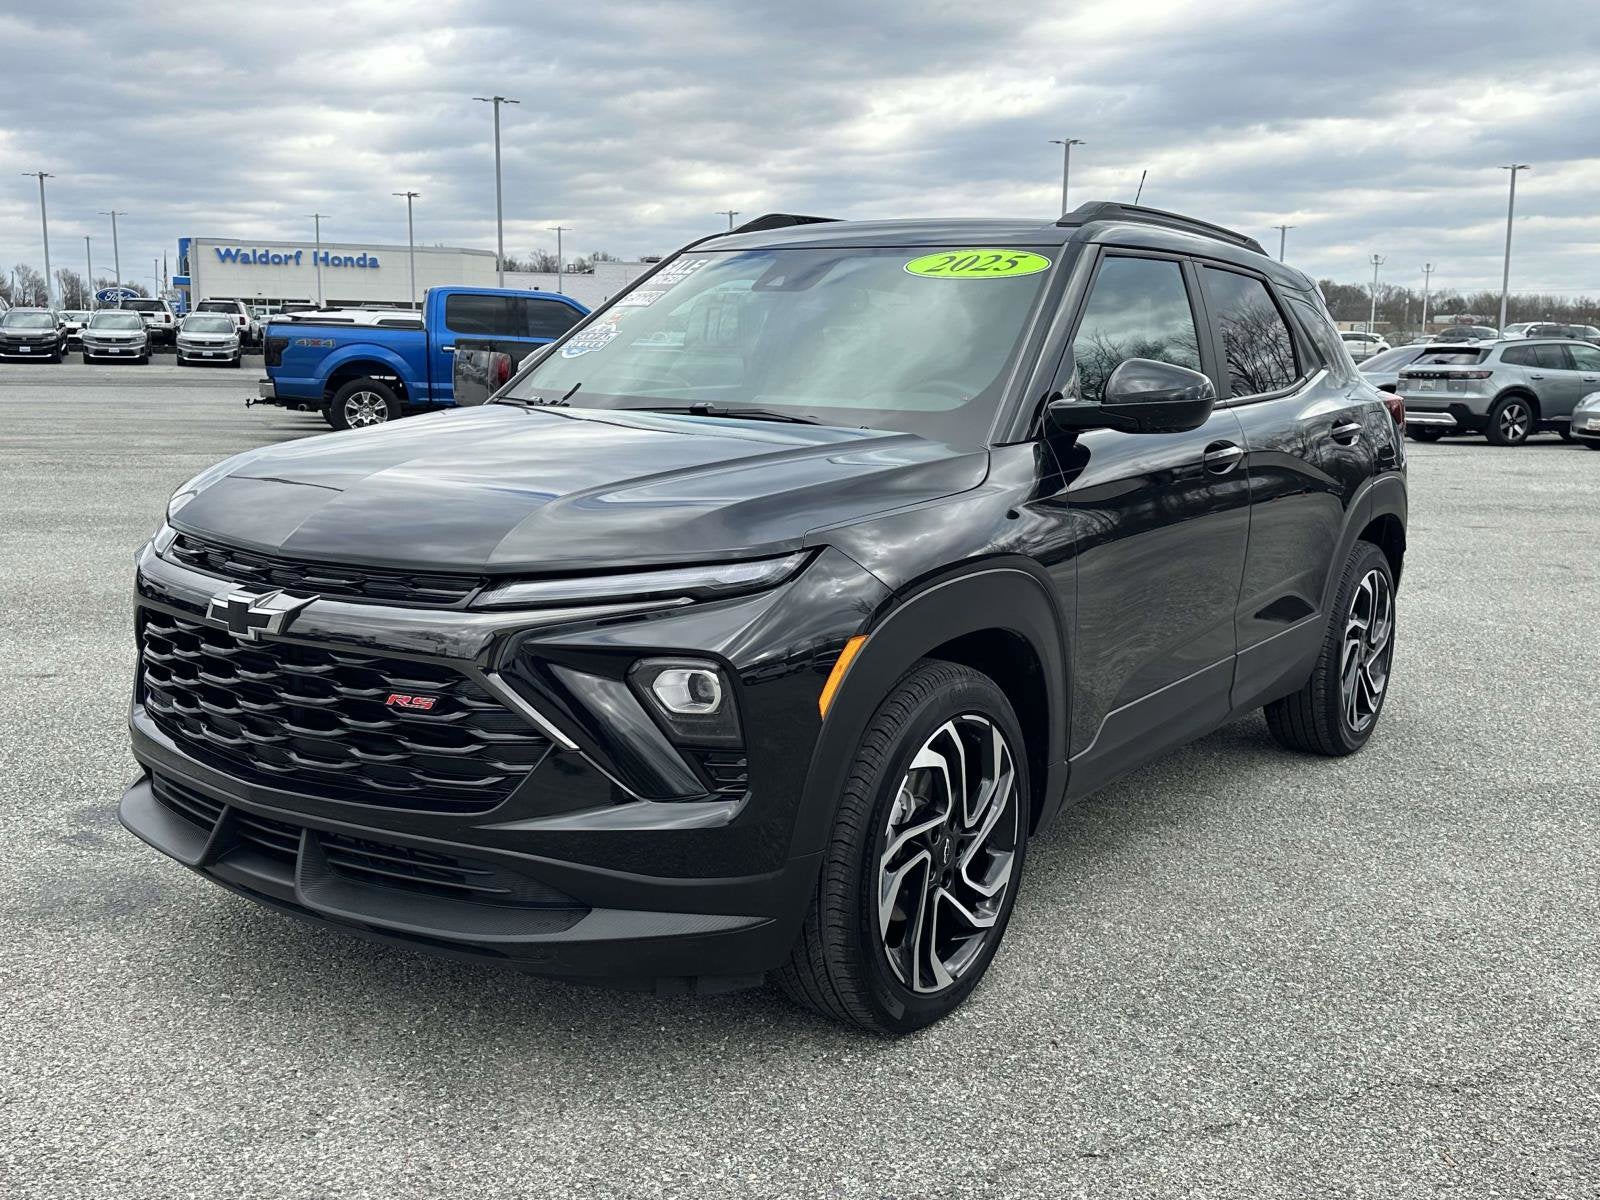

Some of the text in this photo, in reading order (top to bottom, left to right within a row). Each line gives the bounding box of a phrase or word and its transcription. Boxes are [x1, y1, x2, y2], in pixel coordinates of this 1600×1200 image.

[215, 247, 380, 269] Waldorf Honda
[924, 255, 1028, 272] 2025
[385, 693, 437, 710] RS
